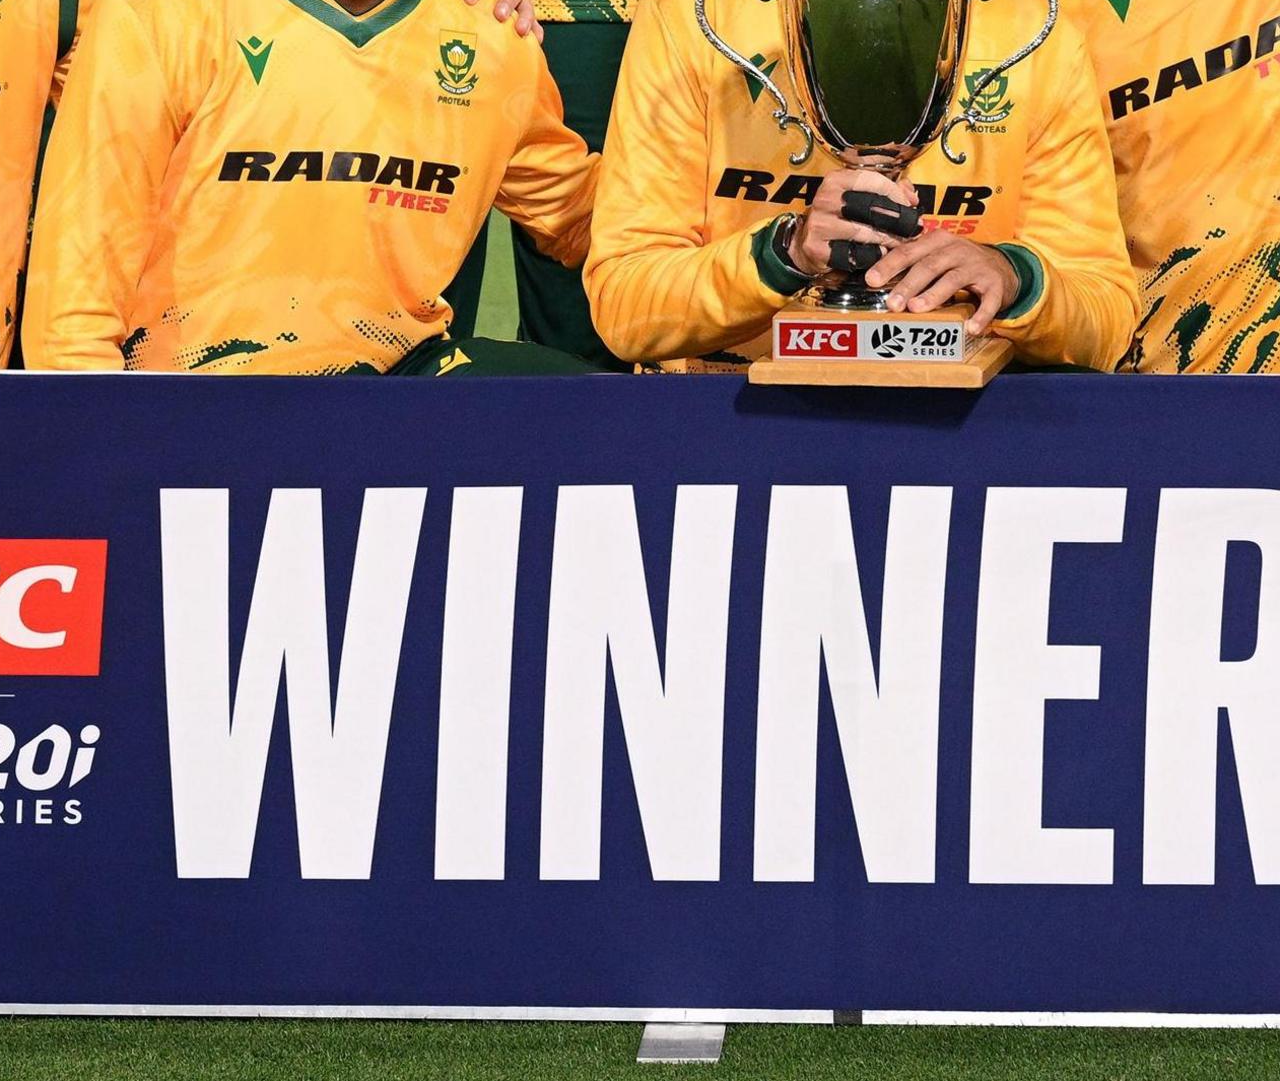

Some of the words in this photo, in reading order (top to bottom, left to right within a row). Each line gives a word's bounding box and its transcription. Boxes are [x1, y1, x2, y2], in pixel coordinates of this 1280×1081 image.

[437, 95, 471, 107] PROTEAS
[218, 151, 461, 195] RADAR
[368, 187, 451, 214] TYRES
[921, 219, 979, 235] RES
[786, 328, 851, 351] KFC
[909, 327, 959, 346] T20i
[913, 348, 956, 357] SERIES
